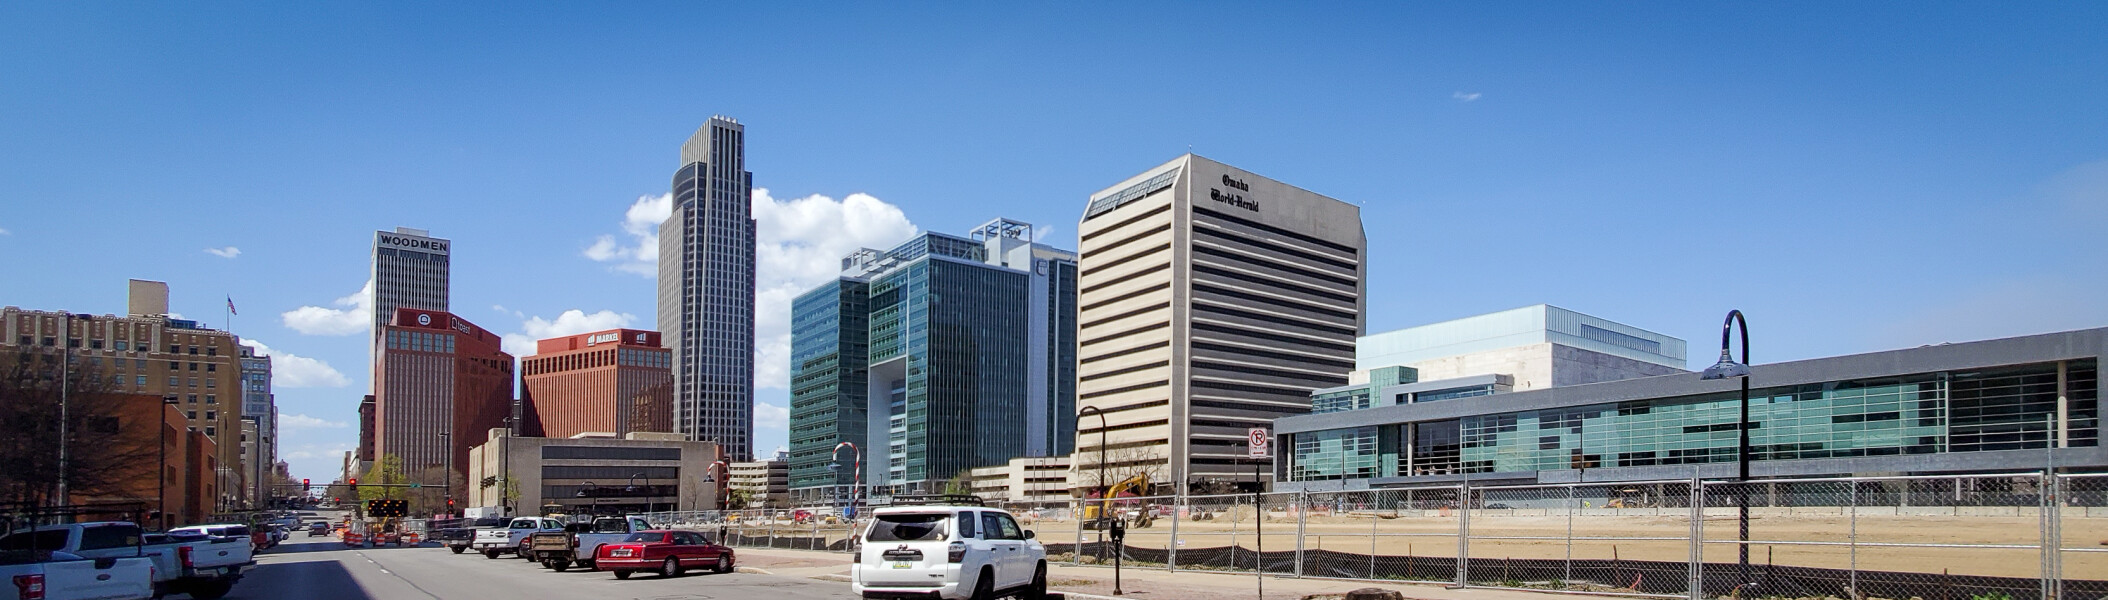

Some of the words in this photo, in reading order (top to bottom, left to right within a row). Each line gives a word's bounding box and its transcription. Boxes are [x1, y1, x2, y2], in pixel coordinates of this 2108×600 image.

[1222, 173, 1249, 192] Omaha
[1210, 187, 1259, 212] World-Herald
[380, 234, 447, 251] WOODMEN
[1255, 432, 1263, 443] P
